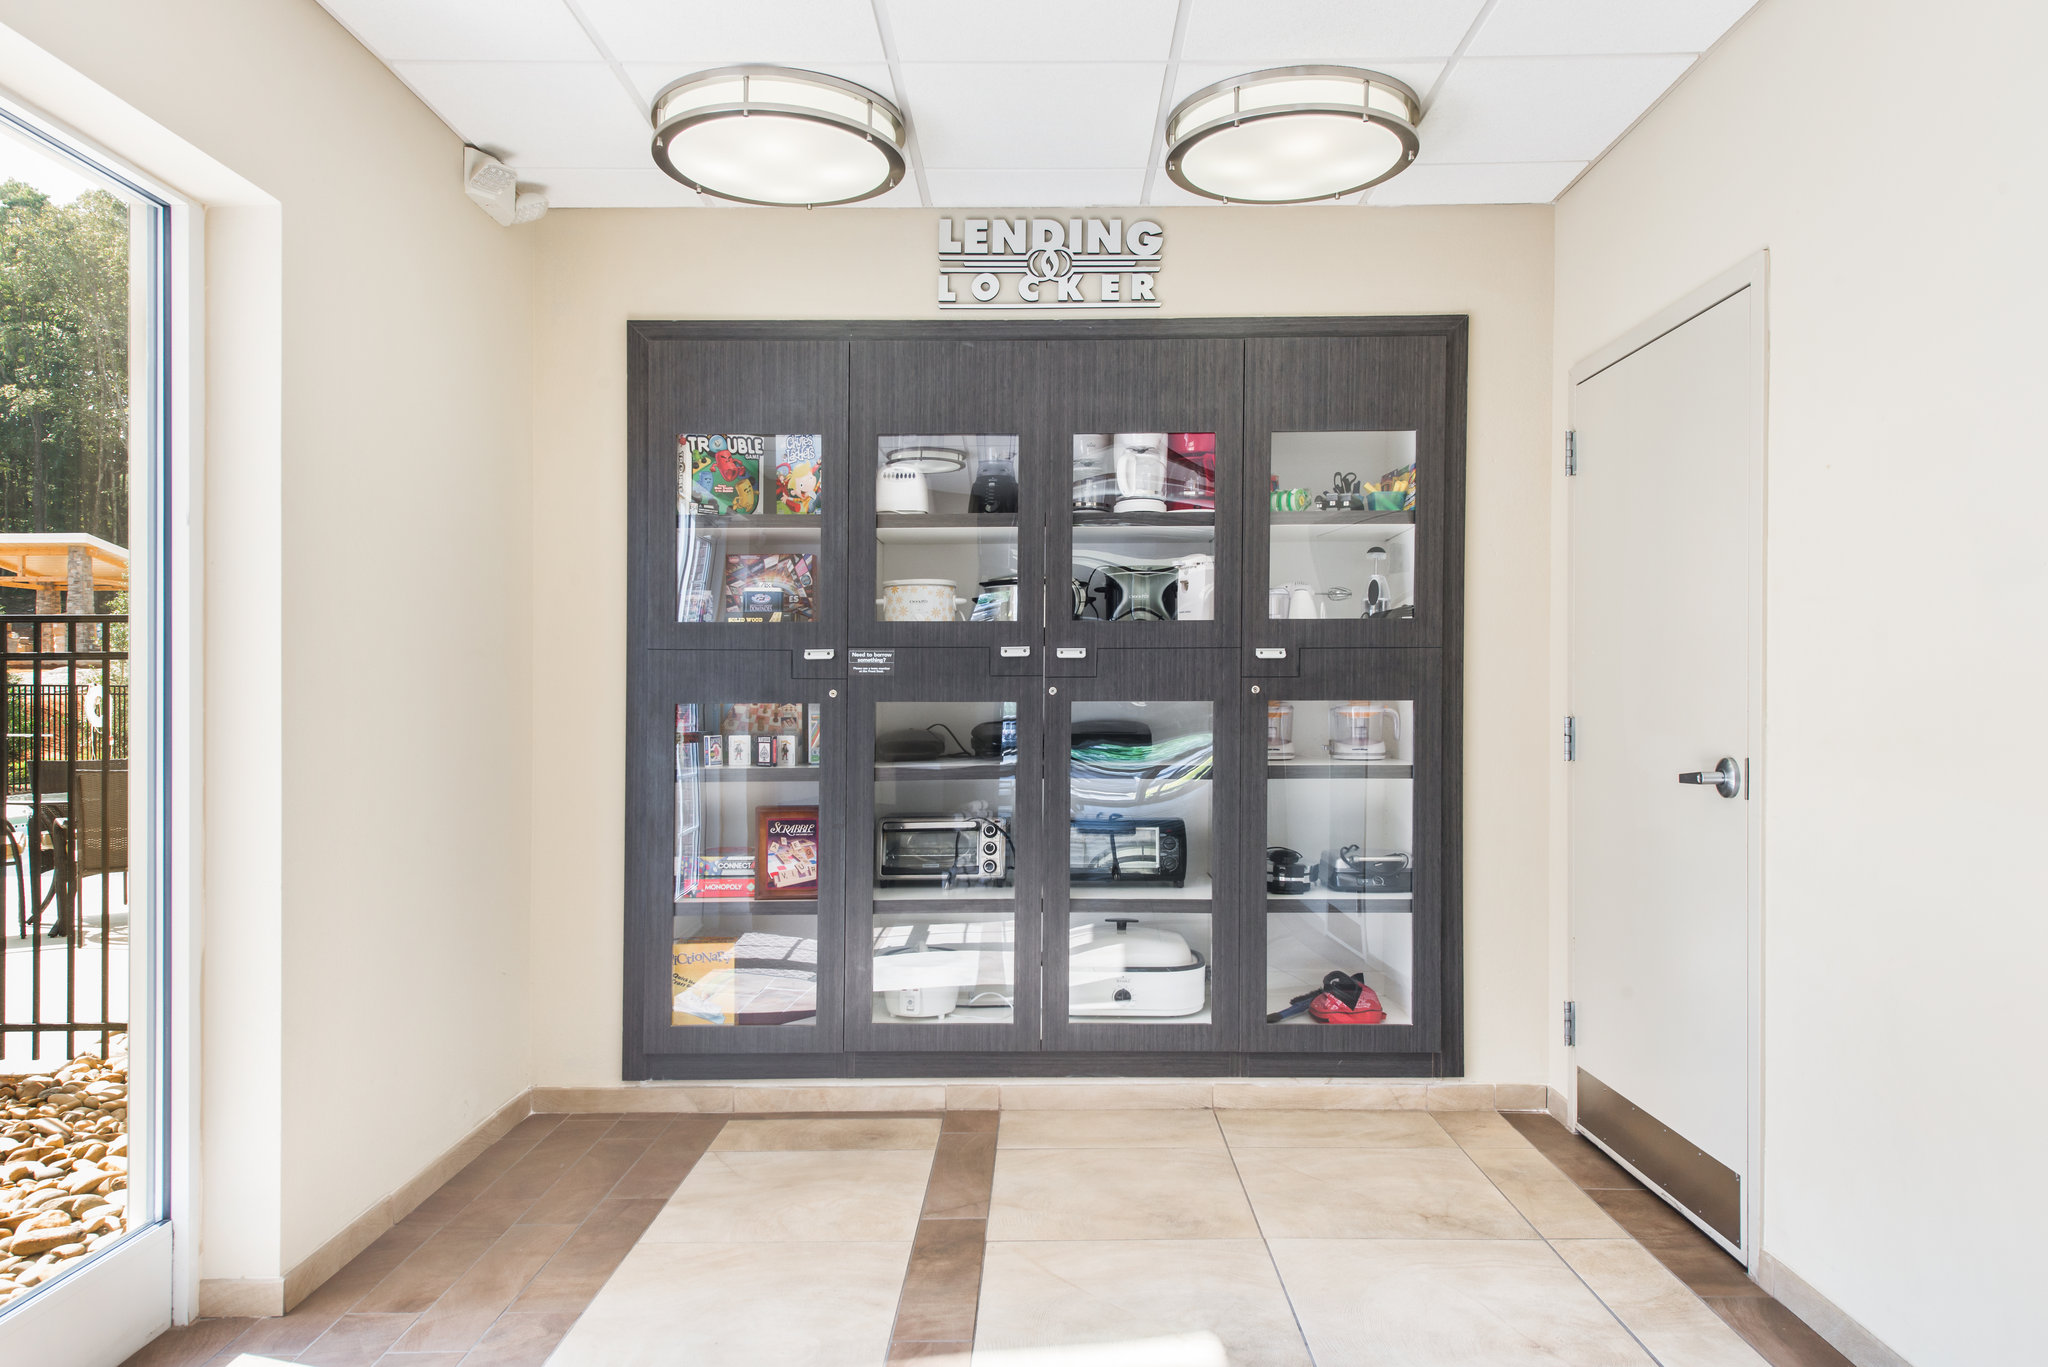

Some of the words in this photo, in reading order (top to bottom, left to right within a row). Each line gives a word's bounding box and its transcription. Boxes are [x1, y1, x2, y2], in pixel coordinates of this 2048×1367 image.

[938, 218, 1164, 256] LENDING
[938, 273, 1156, 302] LOCKER
[686, 434, 764, 455] TROUBLE
[770, 821, 815, 836] SCRABBLE
[717, 861, 752, 869] CONNECT
[672, 972, 688, 982] Quick
